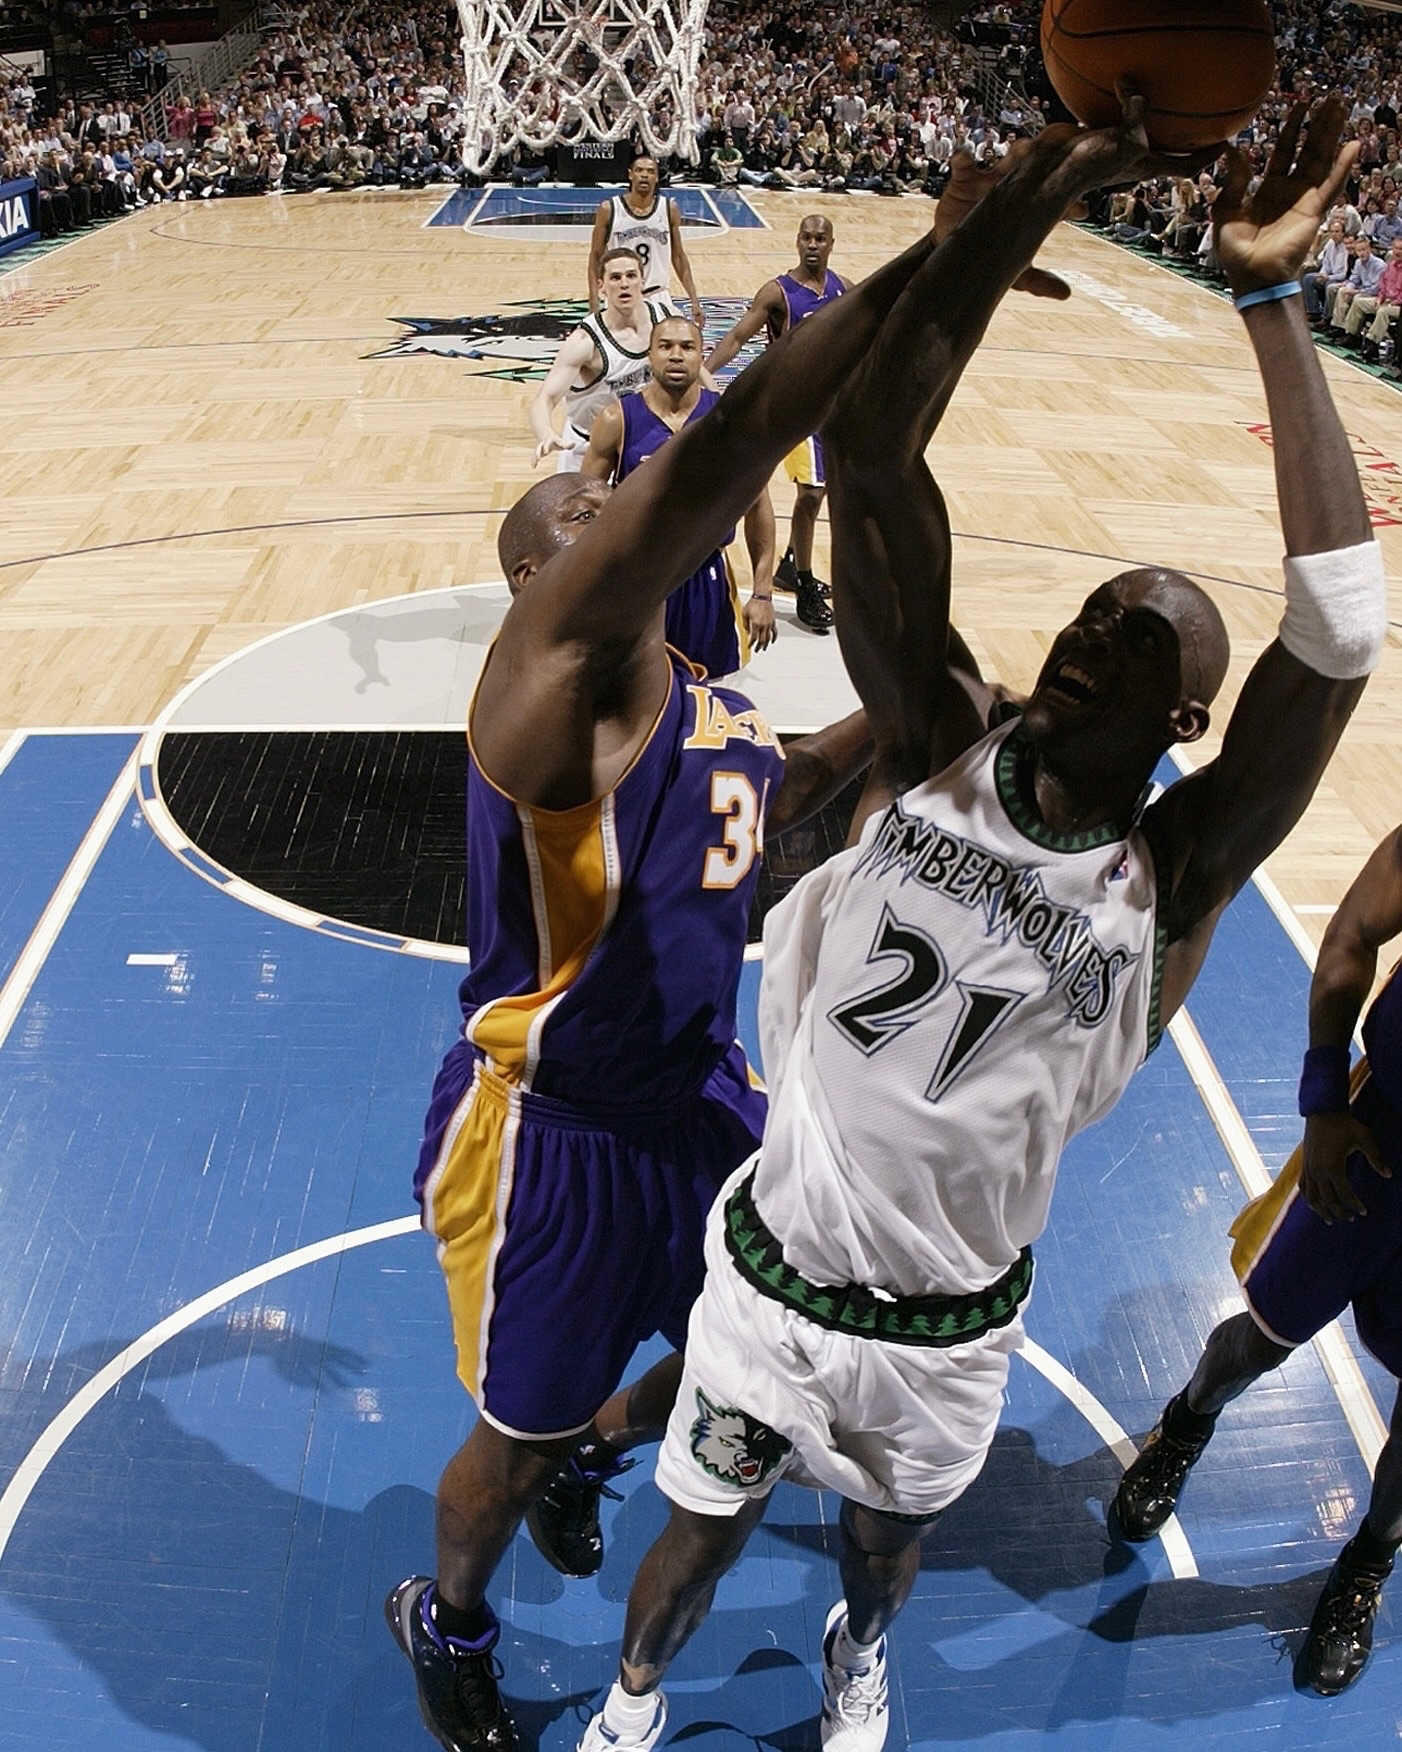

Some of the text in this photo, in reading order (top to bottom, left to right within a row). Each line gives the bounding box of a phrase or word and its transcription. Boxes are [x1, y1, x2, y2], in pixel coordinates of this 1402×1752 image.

[636, 243, 650, 266] 8
[702, 770, 771, 889] 3
[826, 900, 1029, 1104] 21
